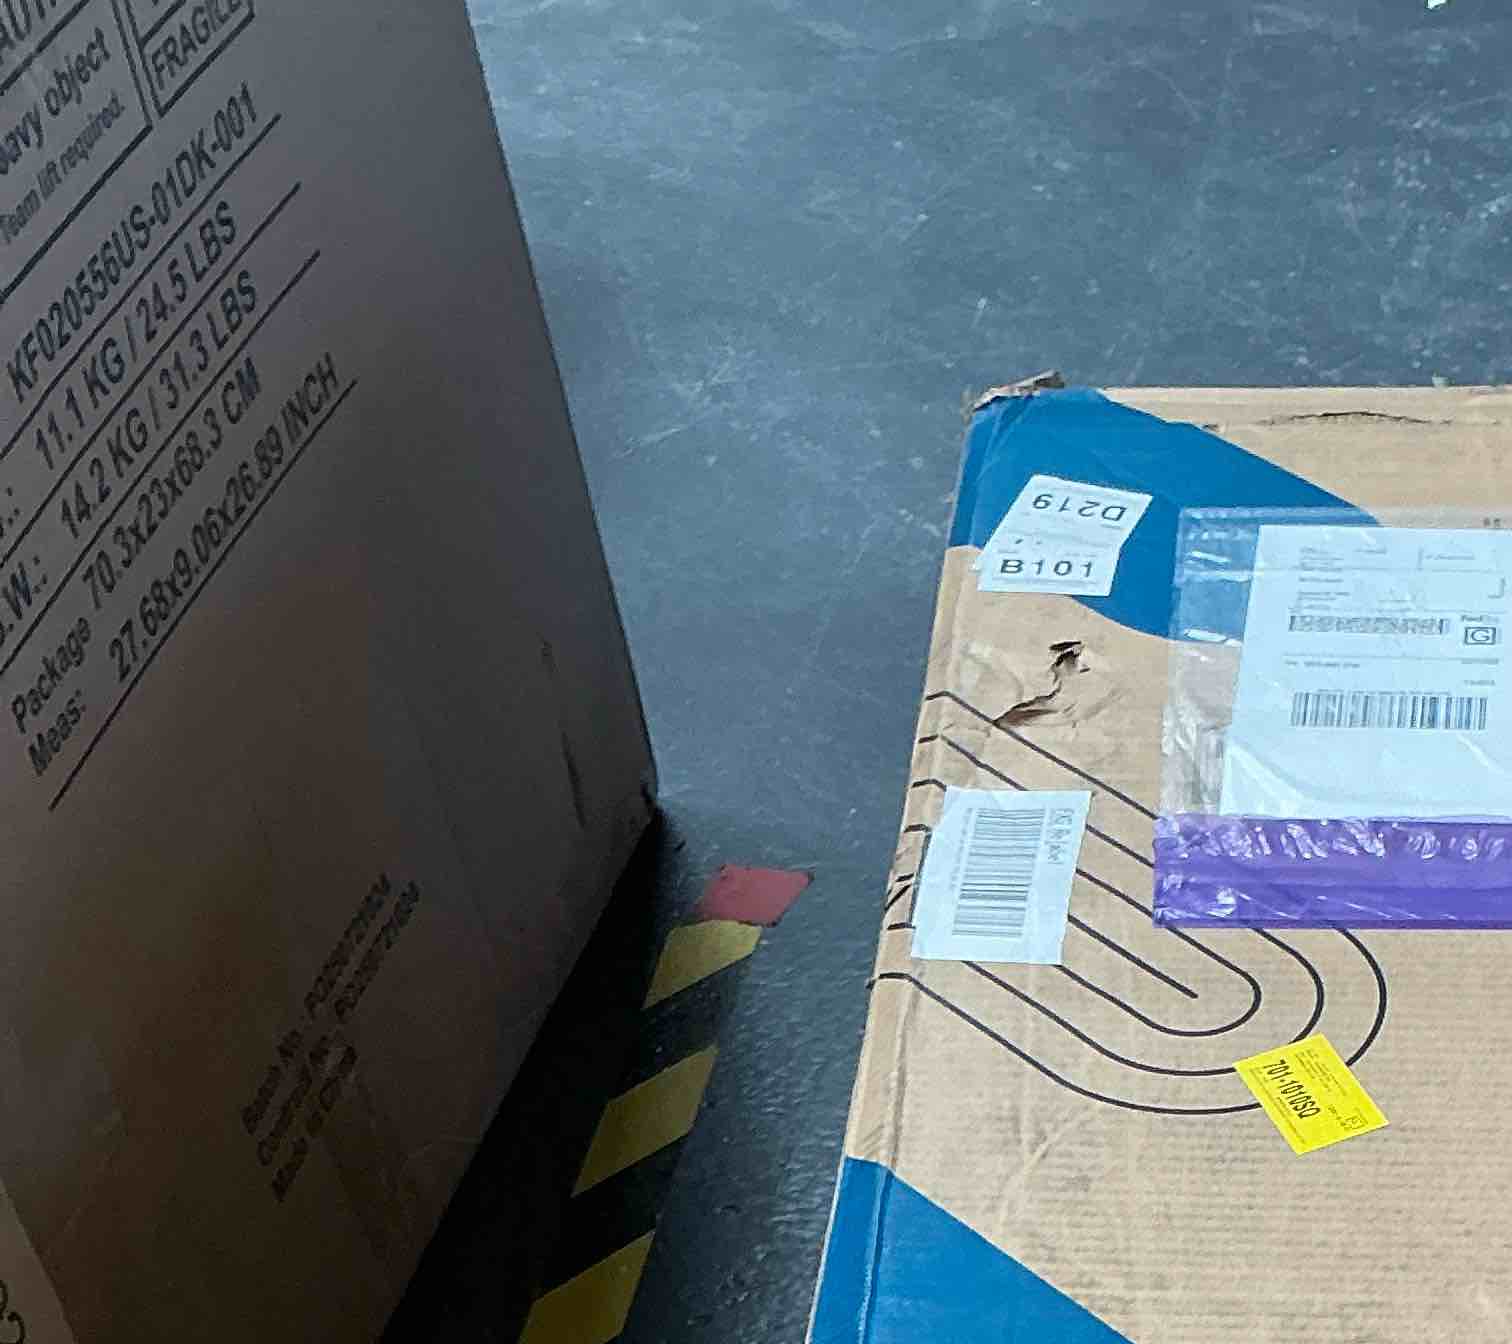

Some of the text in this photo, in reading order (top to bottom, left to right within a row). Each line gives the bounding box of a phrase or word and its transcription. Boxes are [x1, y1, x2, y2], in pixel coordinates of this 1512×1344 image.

[44, 27, 110, 116] object
[35, 387, 85, 469] 11.1
[83, 336, 127, 409] KG
[136, 258, 188, 342] 24.5
[184, 200, 236, 283] LBS
[60, 455, 114, 540] 14.2
[106, 407, 149, 479] KG
[159, 328, 209, 411] 31.3
[206, 270, 257, 350] LBS
[11, 357, 262, 735] Package 70.3x23x68.3 CM
[27, 352, 339, 777] Meas: 27.68x9.06x26.89 INCH
[1000, 559, 1092, 578] B101
[1032, 493, 1127, 522] D219
[1471, 629, 1490, 642] G
